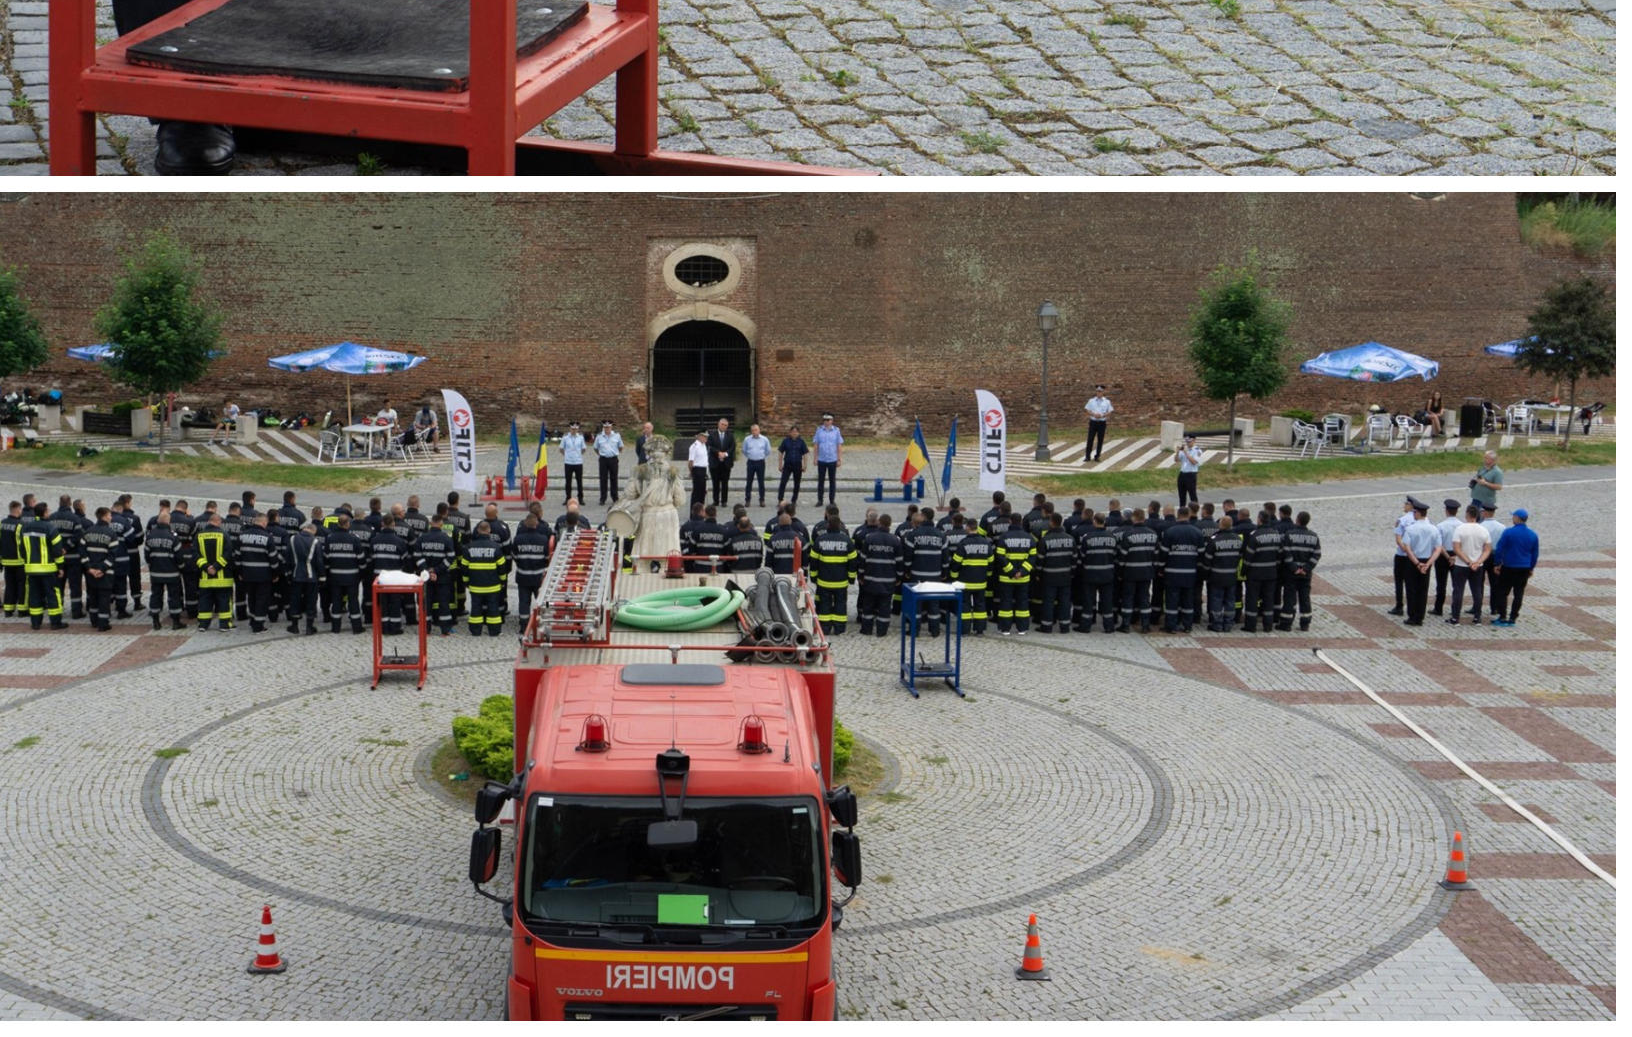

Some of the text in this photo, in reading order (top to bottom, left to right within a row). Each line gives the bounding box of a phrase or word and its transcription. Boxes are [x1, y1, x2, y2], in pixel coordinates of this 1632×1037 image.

[772, 539, 795, 550] POMPIE
[556, 987, 782, 998] VOLVO FL
